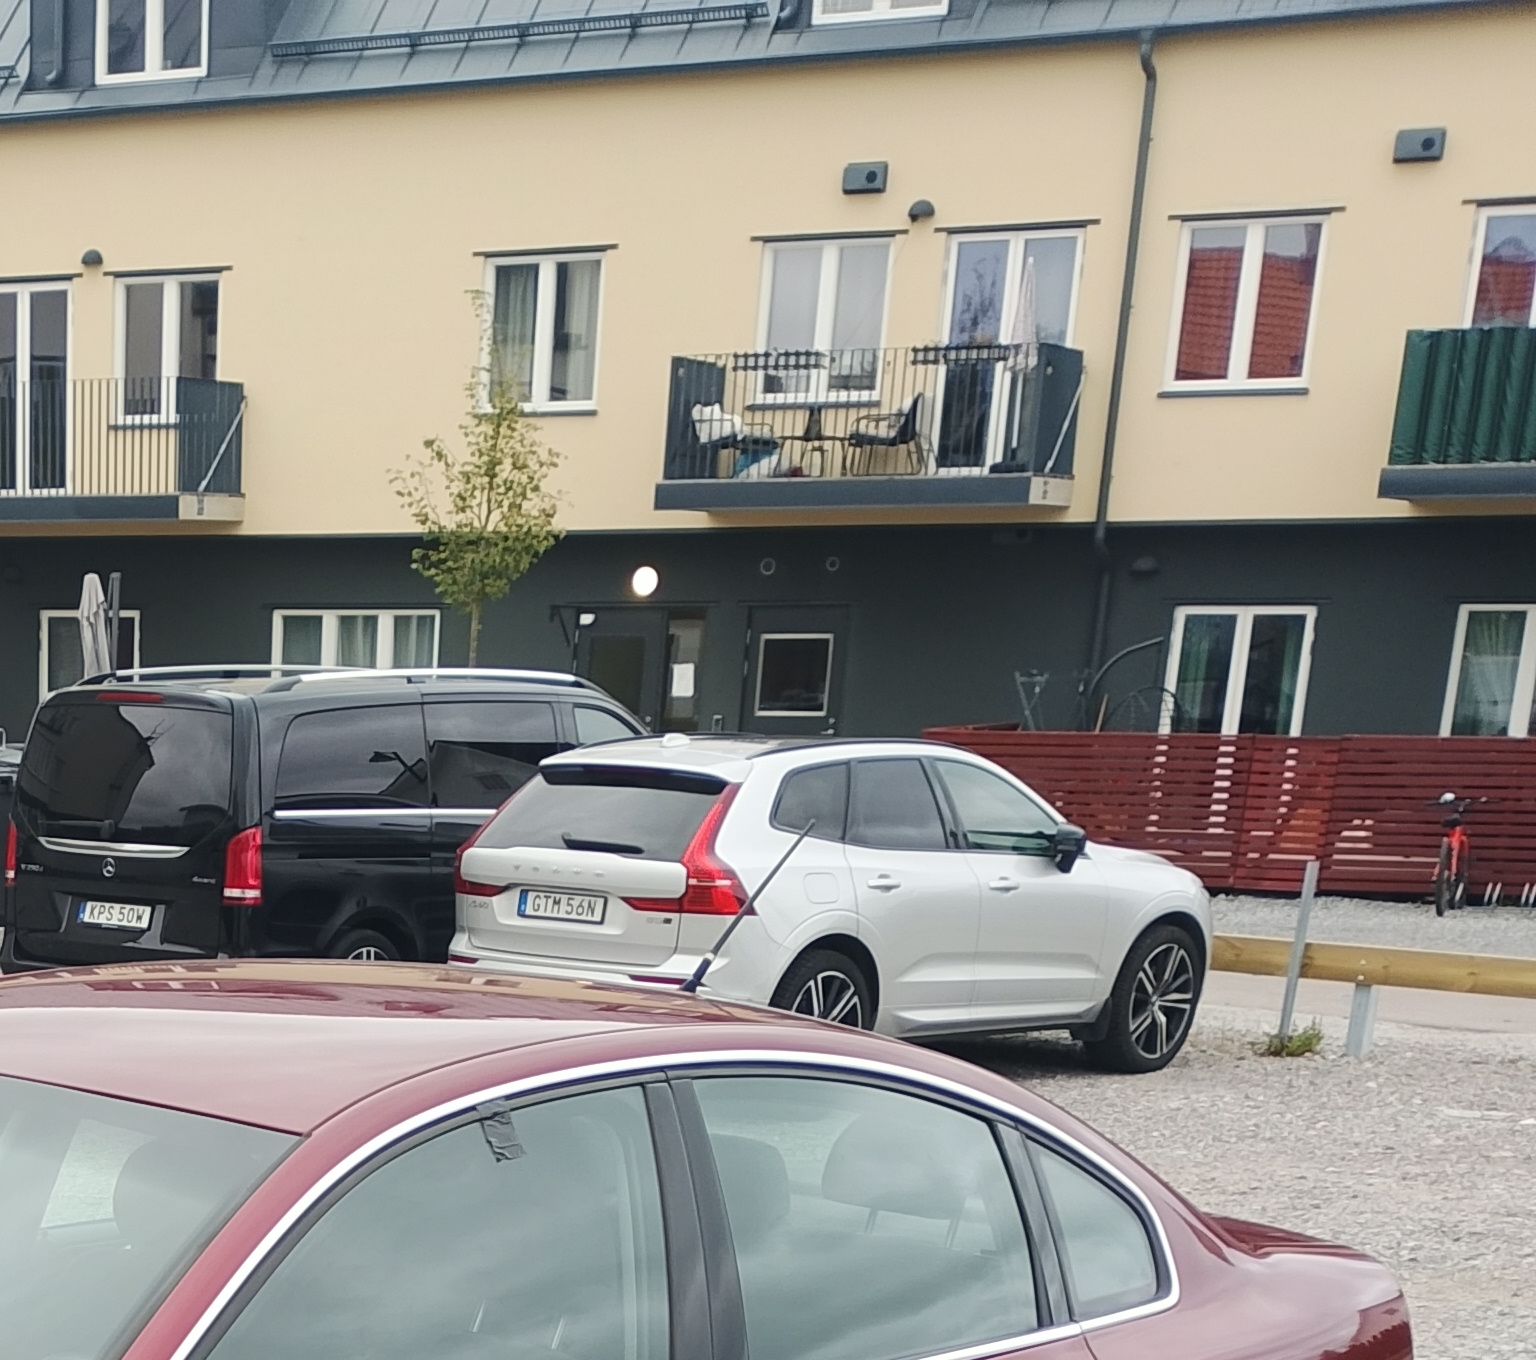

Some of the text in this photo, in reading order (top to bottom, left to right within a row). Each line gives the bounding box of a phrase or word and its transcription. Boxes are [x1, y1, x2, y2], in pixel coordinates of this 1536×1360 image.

[88, 903, 146, 924] KPS 50W
[532, 894, 597, 918] GTM 56N
